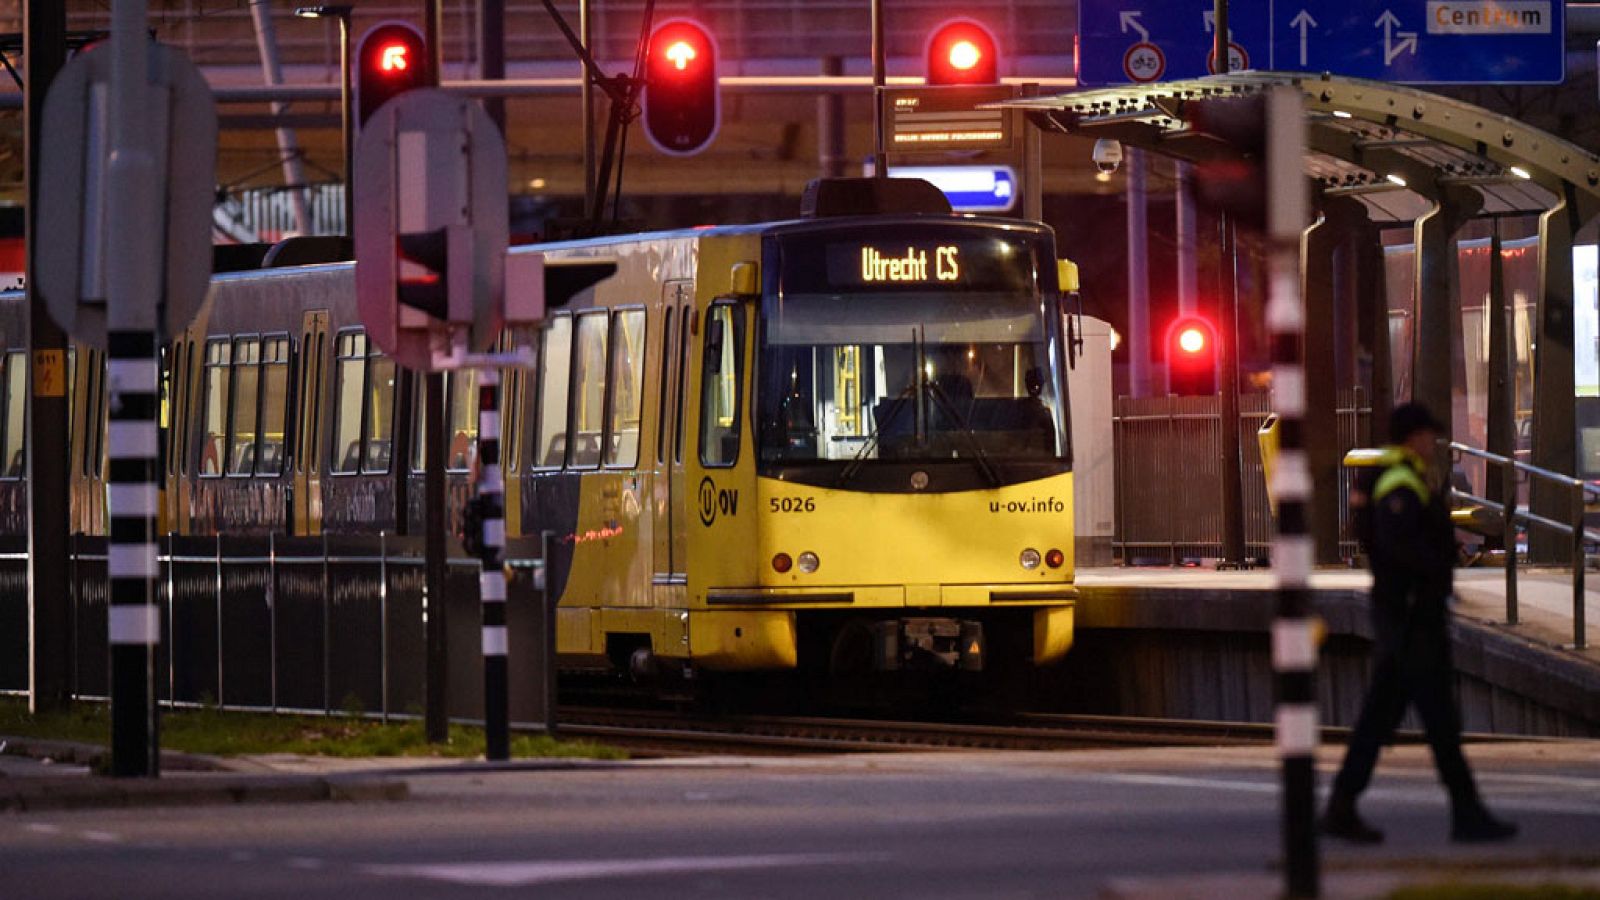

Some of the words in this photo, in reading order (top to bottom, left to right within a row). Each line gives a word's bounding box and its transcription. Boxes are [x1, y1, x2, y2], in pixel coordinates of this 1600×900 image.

[1436, 5, 1541, 26] Centrum
[862, 246, 928, 281] Utrecht
[936, 246, 959, 281] CS
[769, 496, 816, 513] 5026
[989, 496, 1065, 513] u-ov.info
